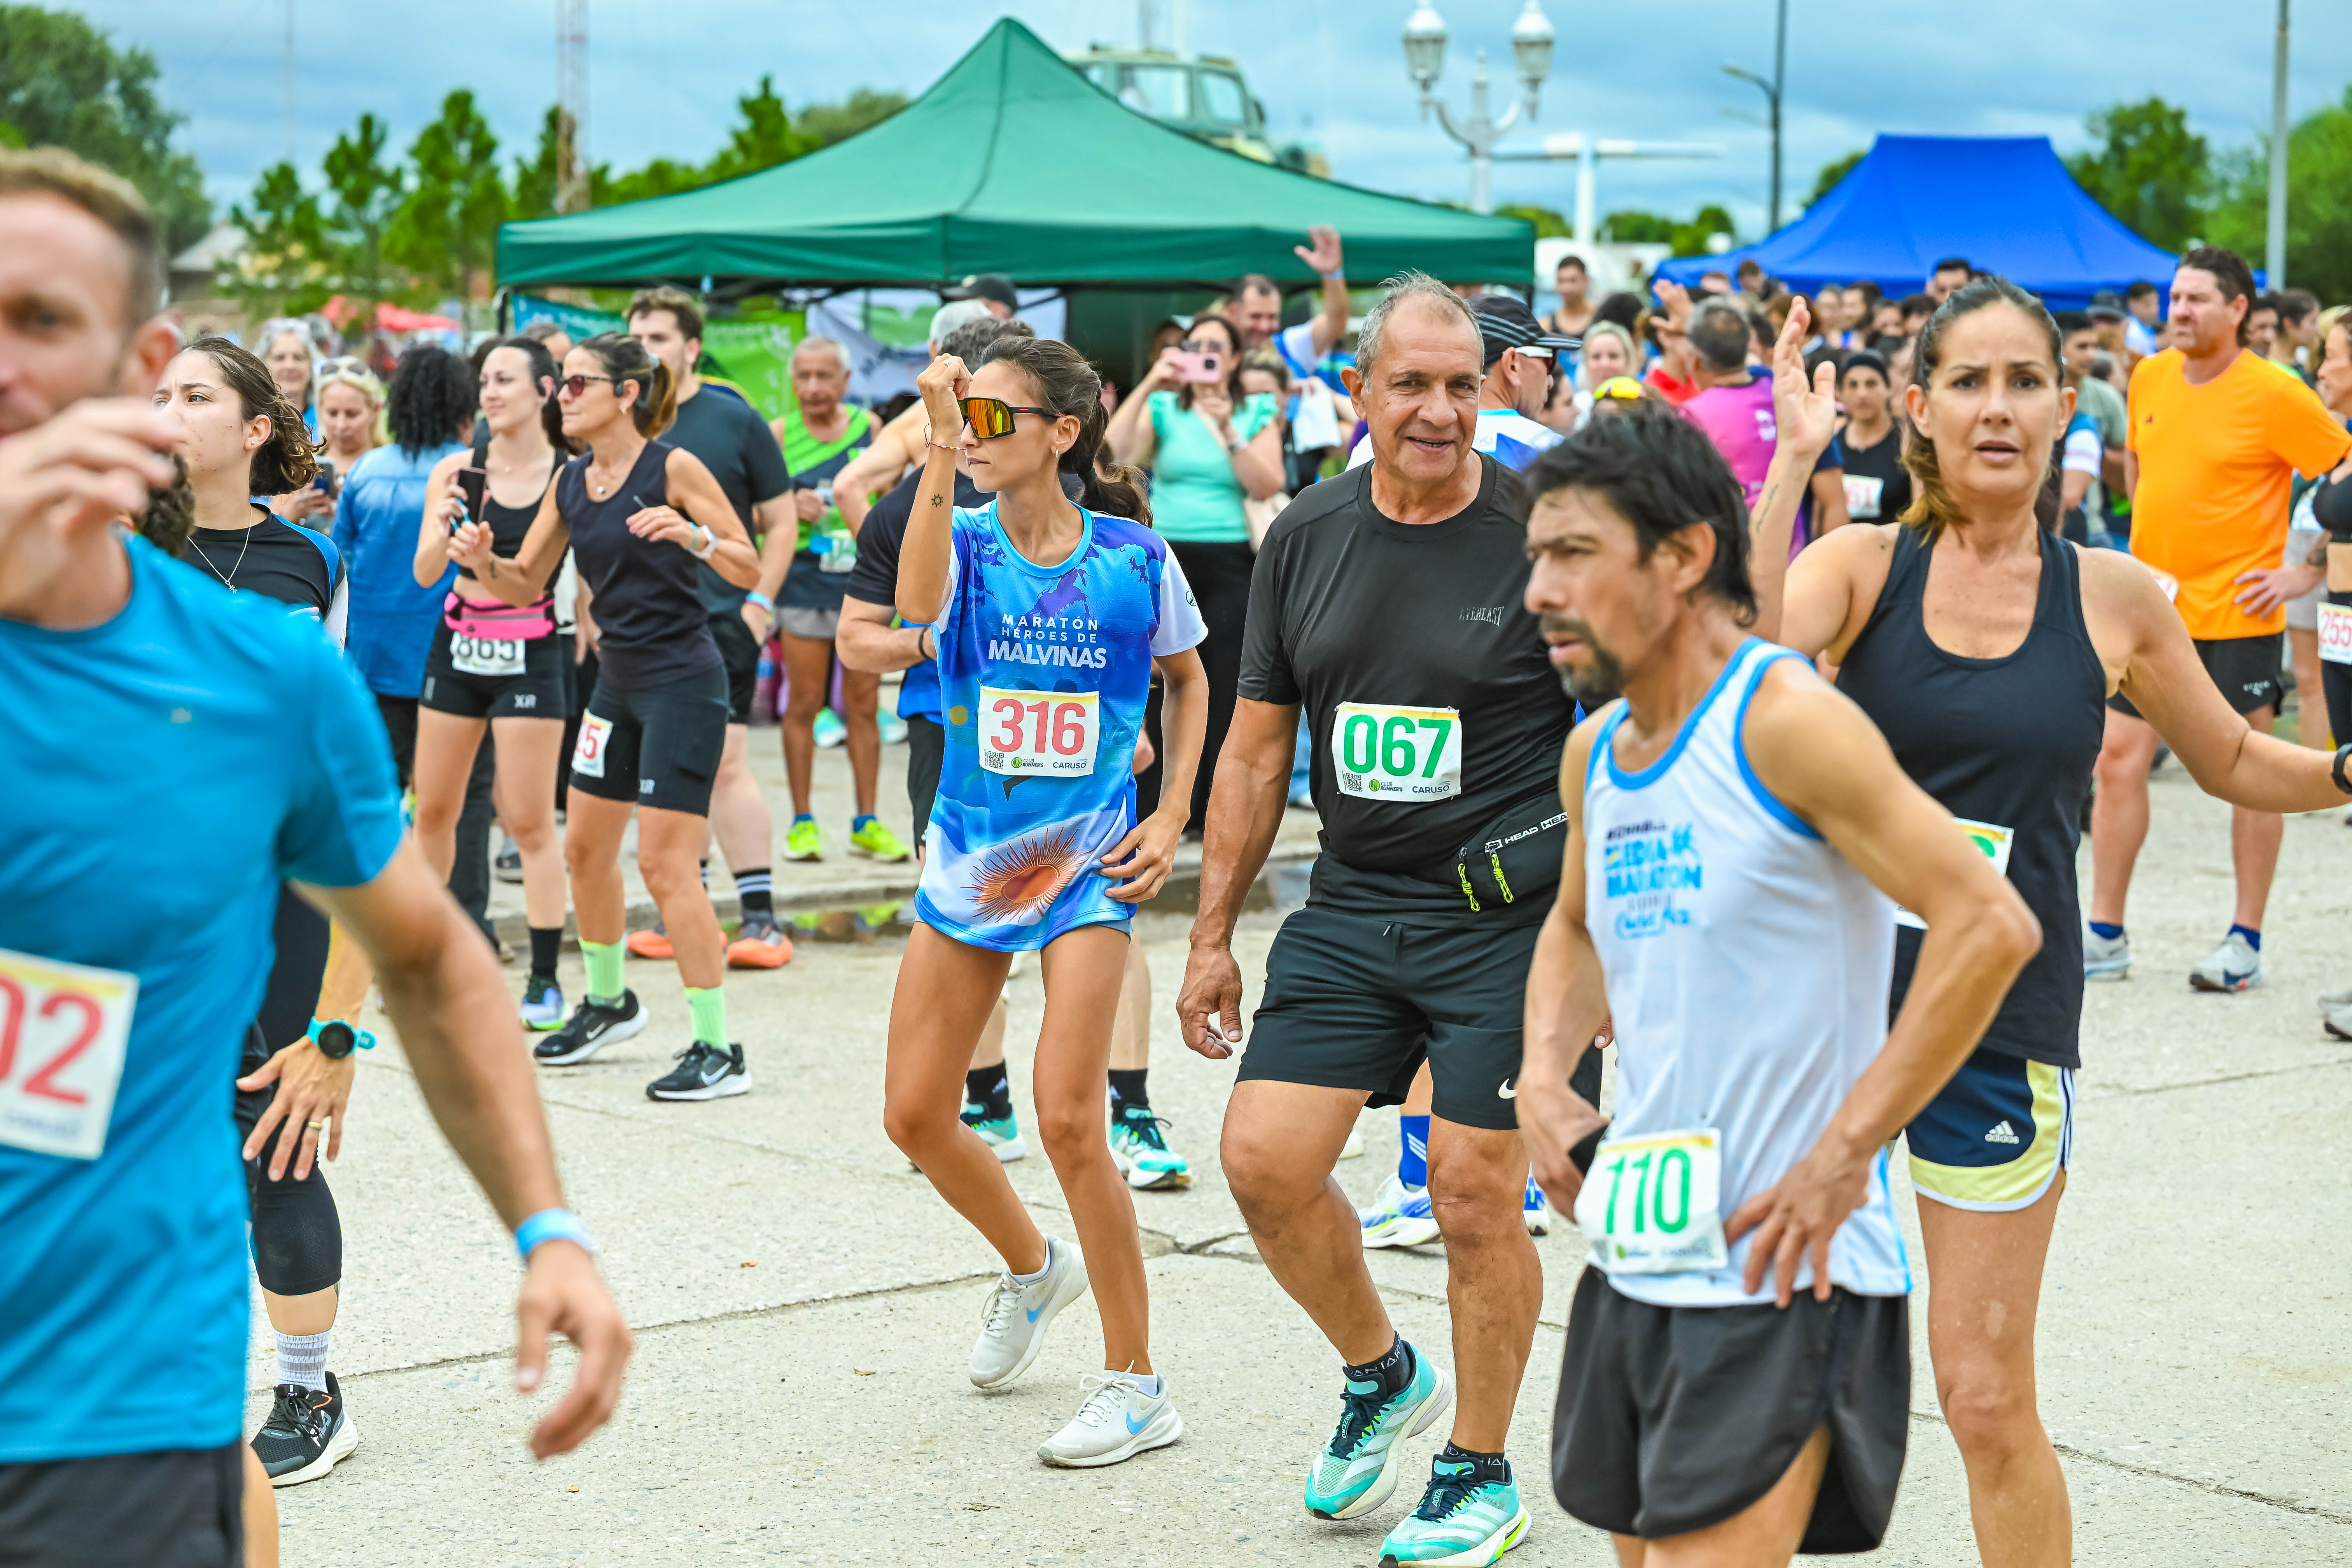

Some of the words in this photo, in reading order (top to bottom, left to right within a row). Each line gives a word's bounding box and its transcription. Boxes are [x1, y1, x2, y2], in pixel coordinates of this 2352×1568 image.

[1002, 613, 1097, 631] MARATÓN
[1002, 627, 1067, 642] HÉROES
[1078, 633, 1097, 643] DE
[2319, 611, 2352, 647] 255
[988, 640, 1107, 668] MALVINAS
[990, 698, 1086, 755] 316
[1344, 714, 1451, 778] 067
[1412, 785, 1449, 793] CARUSO
[1504, 826, 1538, 844] HEAD
[1542, 814, 1568, 828] HEA
[1985, 1133, 2020, 1144] adidas
[1606, 1148, 1691, 1234] 110
[1341, 1412, 1354, 1438] ADIZERO
